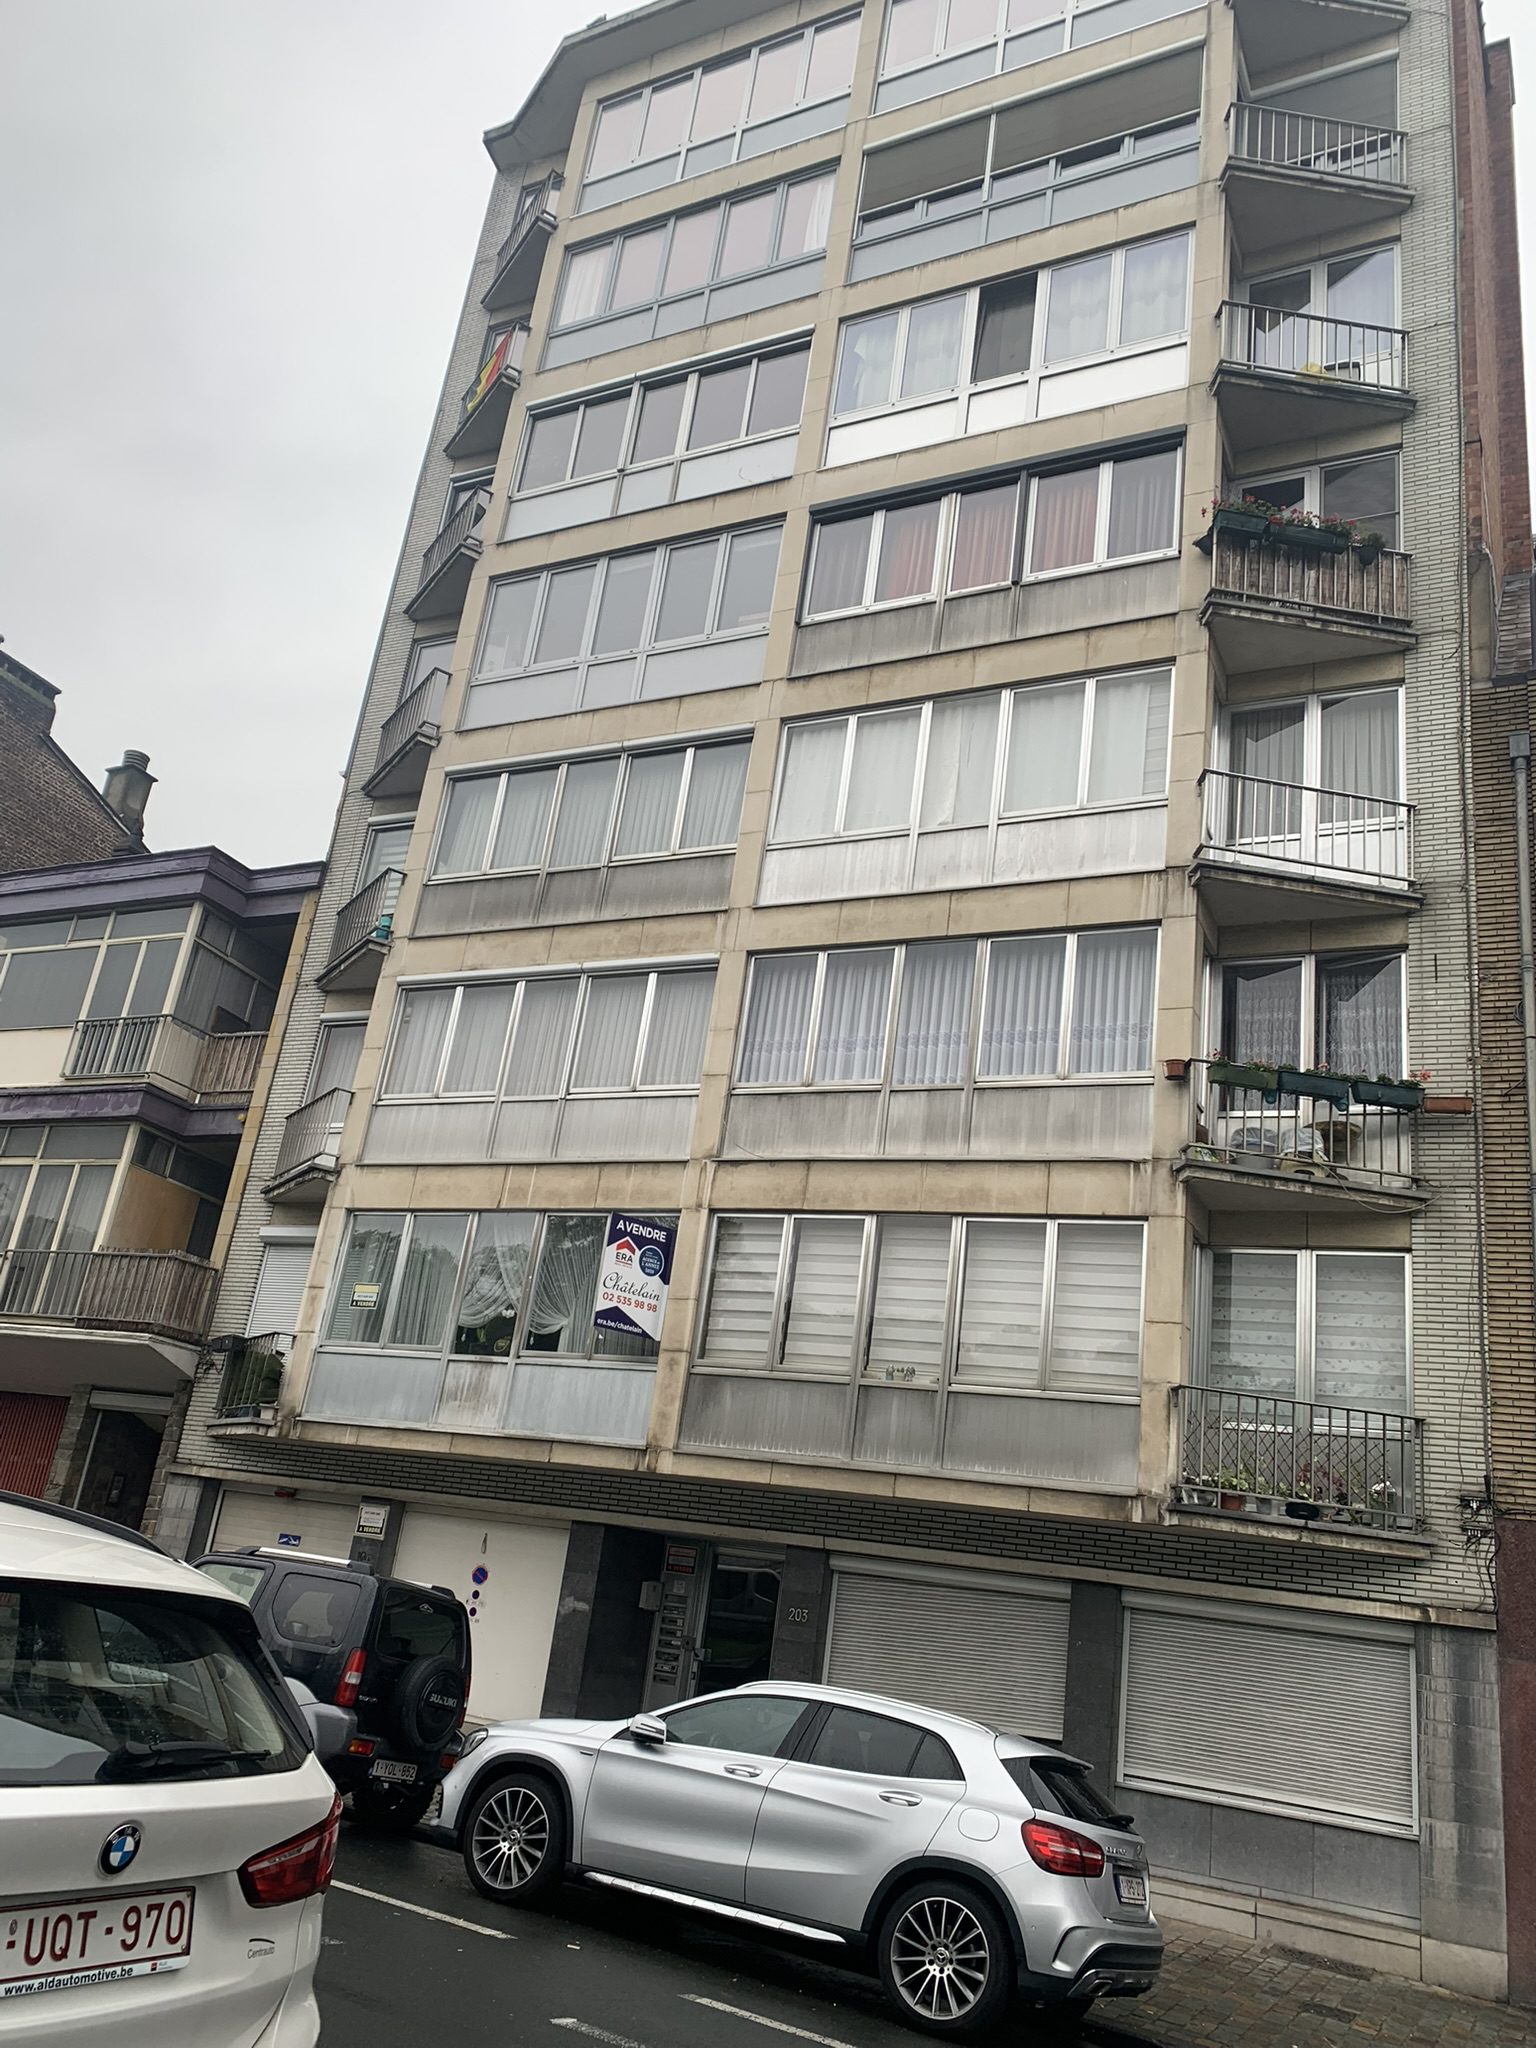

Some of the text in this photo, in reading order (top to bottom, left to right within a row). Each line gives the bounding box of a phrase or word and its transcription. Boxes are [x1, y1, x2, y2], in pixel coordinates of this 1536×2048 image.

[616, 1219, 667, 1242] A VENDRE
[615, 1252, 633, 1263] ERA
[602, 1272, 660, 1301] Châtelain
[602, 1291, 657, 1313] 02 535 98 98
[596, 1318, 643, 1334] era.be/chatelain
[788, 1607, 808, 1622] 203
[429, 1693, 457, 1707] SUZUKI
[4, 1966, 134, 1996] www.aldautomotive.be
